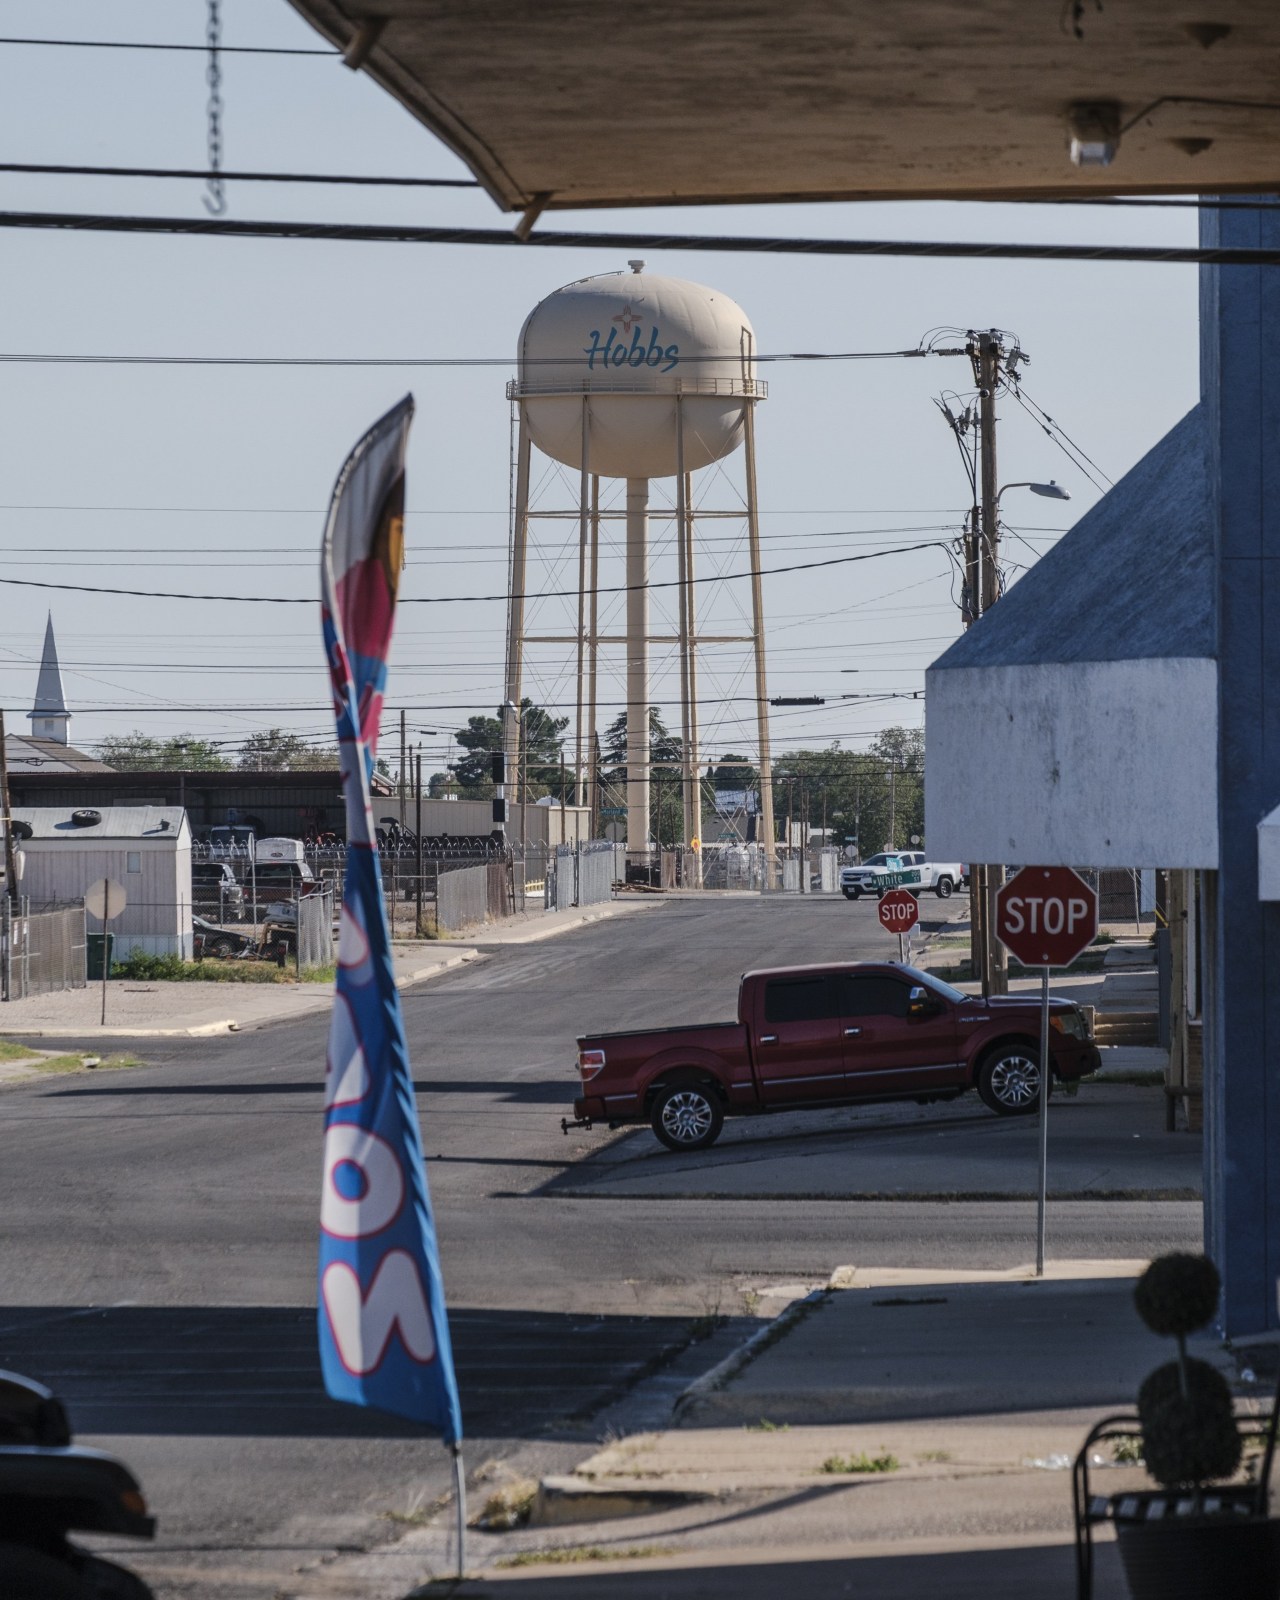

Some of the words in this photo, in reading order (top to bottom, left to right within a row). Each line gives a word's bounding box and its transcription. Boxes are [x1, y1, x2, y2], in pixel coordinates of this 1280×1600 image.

[583, 326, 680, 373] Hobbs
[877, 874, 903, 887] White
[882, 903, 915, 921] STOP
[1004, 897, 1088, 935] STOP
